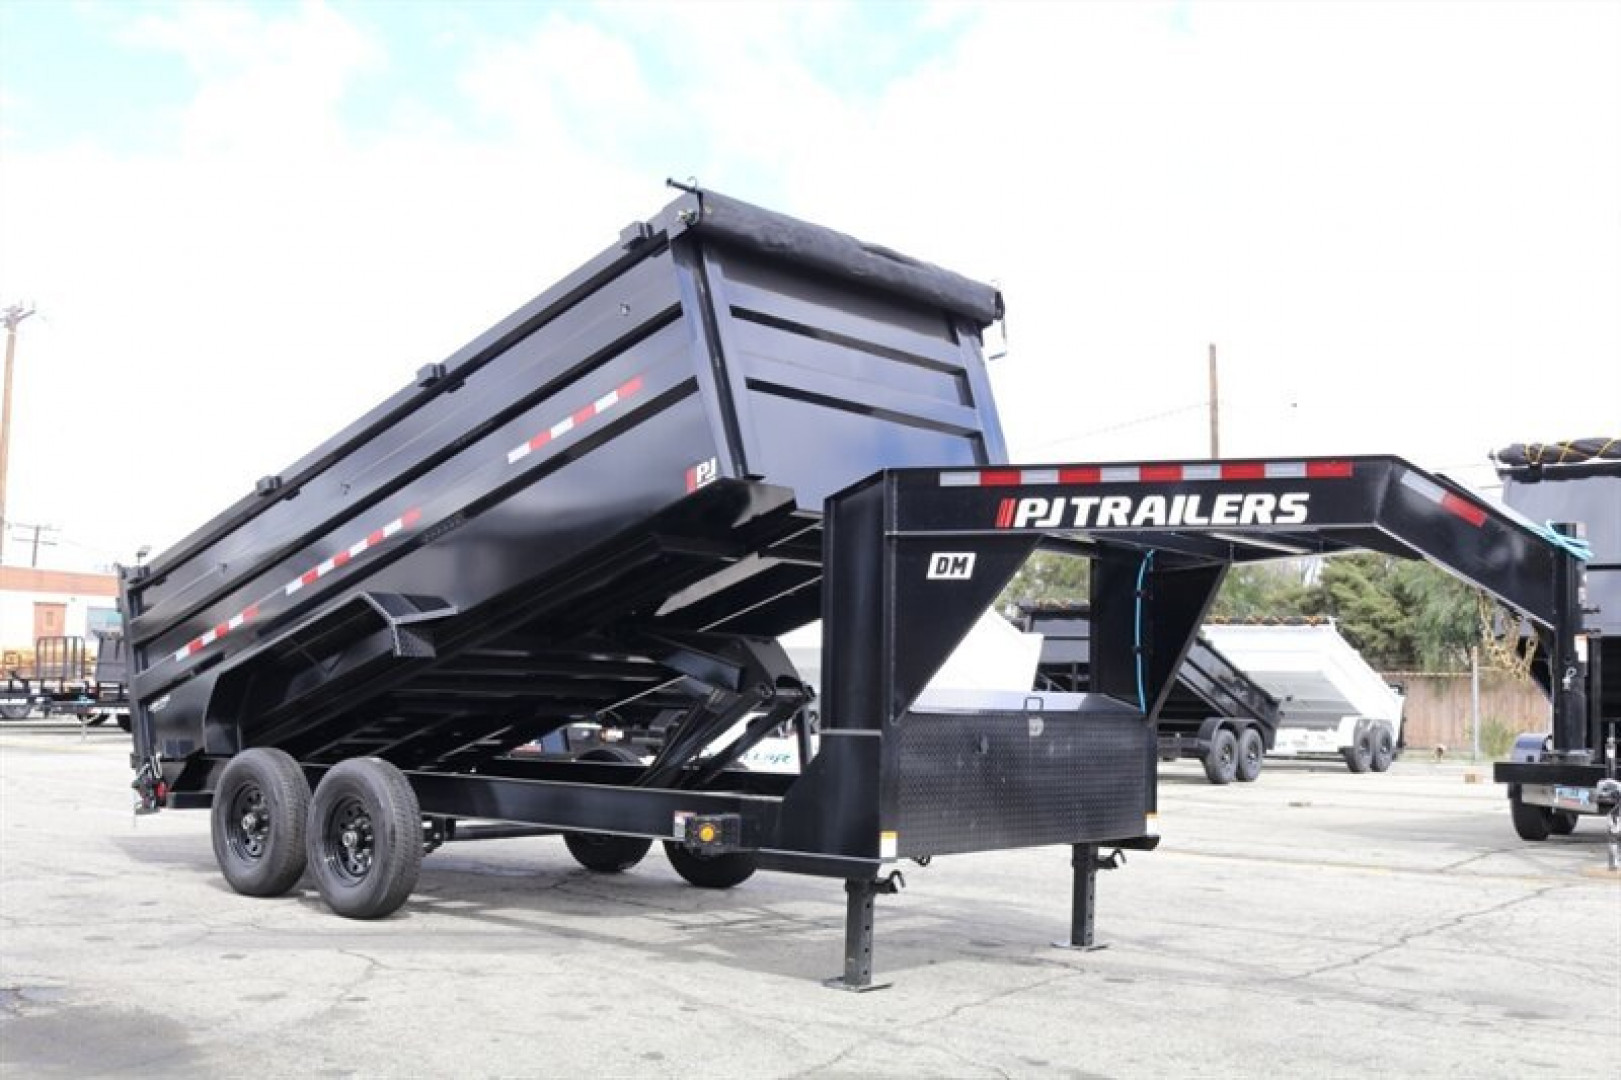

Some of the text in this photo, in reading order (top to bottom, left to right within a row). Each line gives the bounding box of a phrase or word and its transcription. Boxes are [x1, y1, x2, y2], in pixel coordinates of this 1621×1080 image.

[697, 457, 717, 483] PJ
[1069, 492, 1310, 527] TRAILERS
[935, 556, 970, 576] DM
